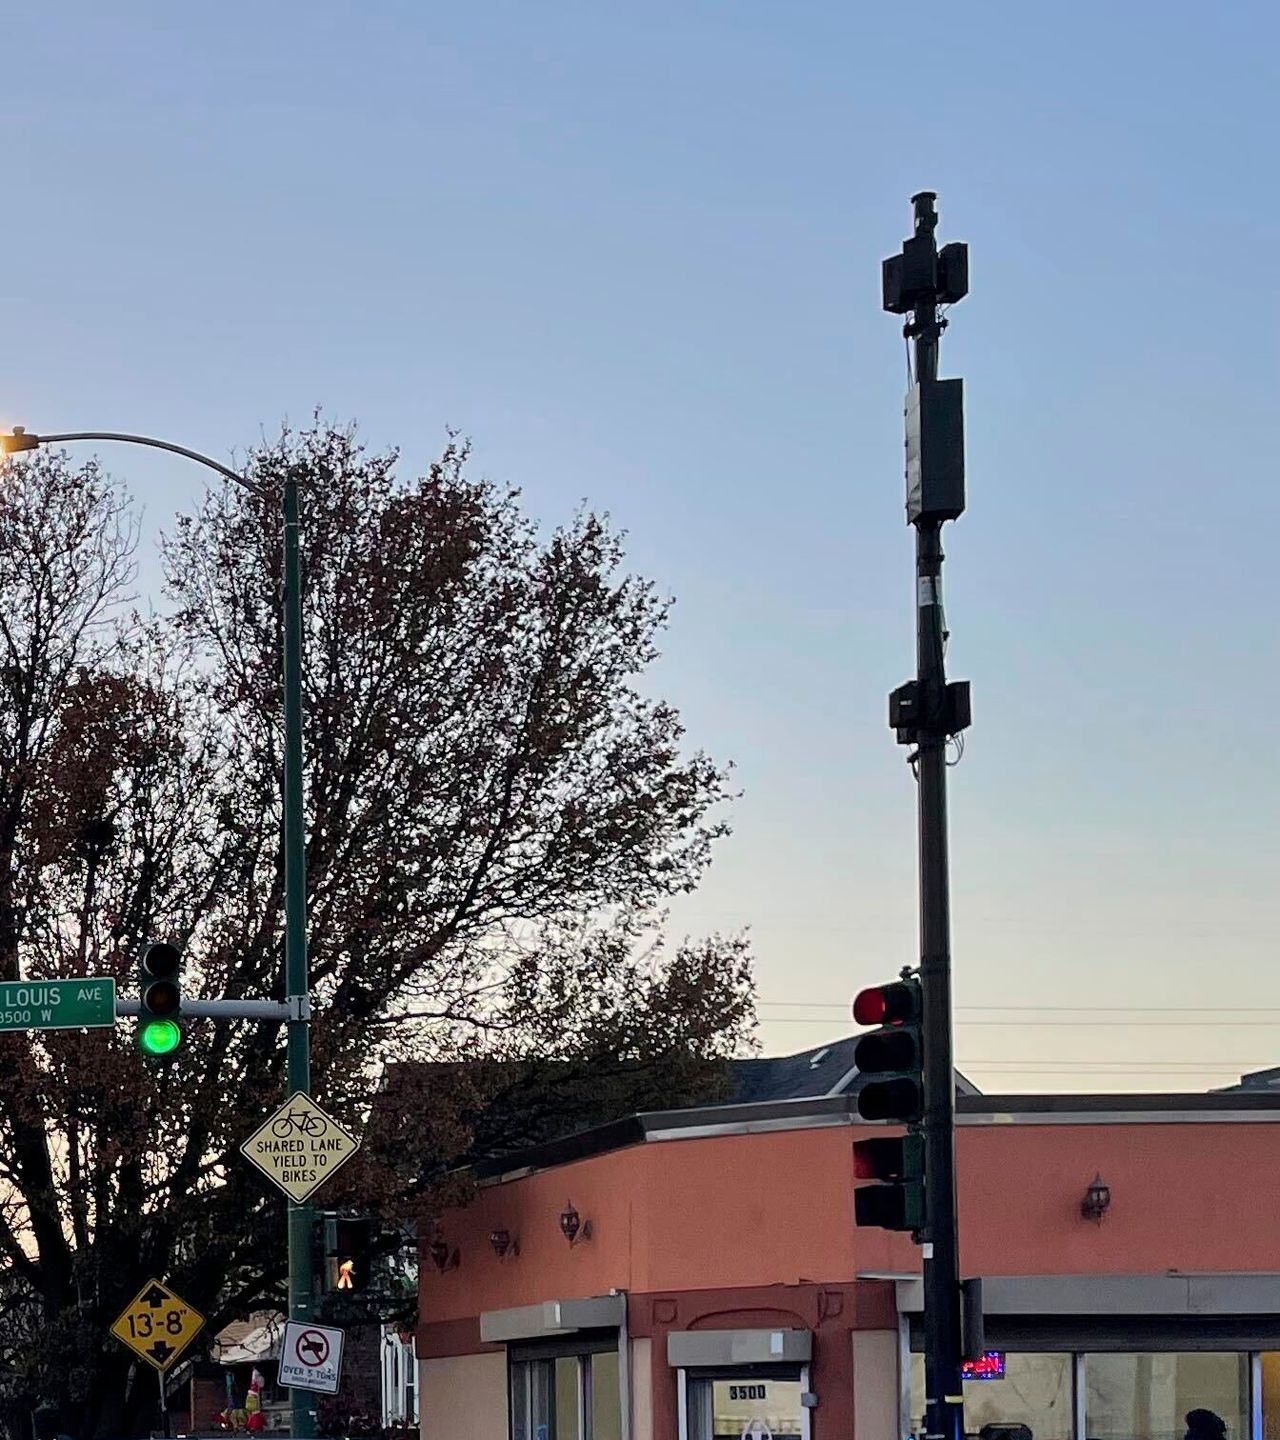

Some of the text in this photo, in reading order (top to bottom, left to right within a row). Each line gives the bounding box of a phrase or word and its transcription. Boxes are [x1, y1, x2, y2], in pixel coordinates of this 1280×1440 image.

[5, 988, 61, 1008] LOUIS
[77, 987, 103, 1002] AVE
[41, 1009, 52, 1023] W
[256, 1138, 344, 1153] SHARED LANE
[272, 1154, 327, 1168] YIELD TO
[282, 1170, 317, 1182] BIKES
[283, 1365, 304, 1376] OVER
[307, 1368, 313, 1378] 5
[729, 1385, 766, 1400] 3500
